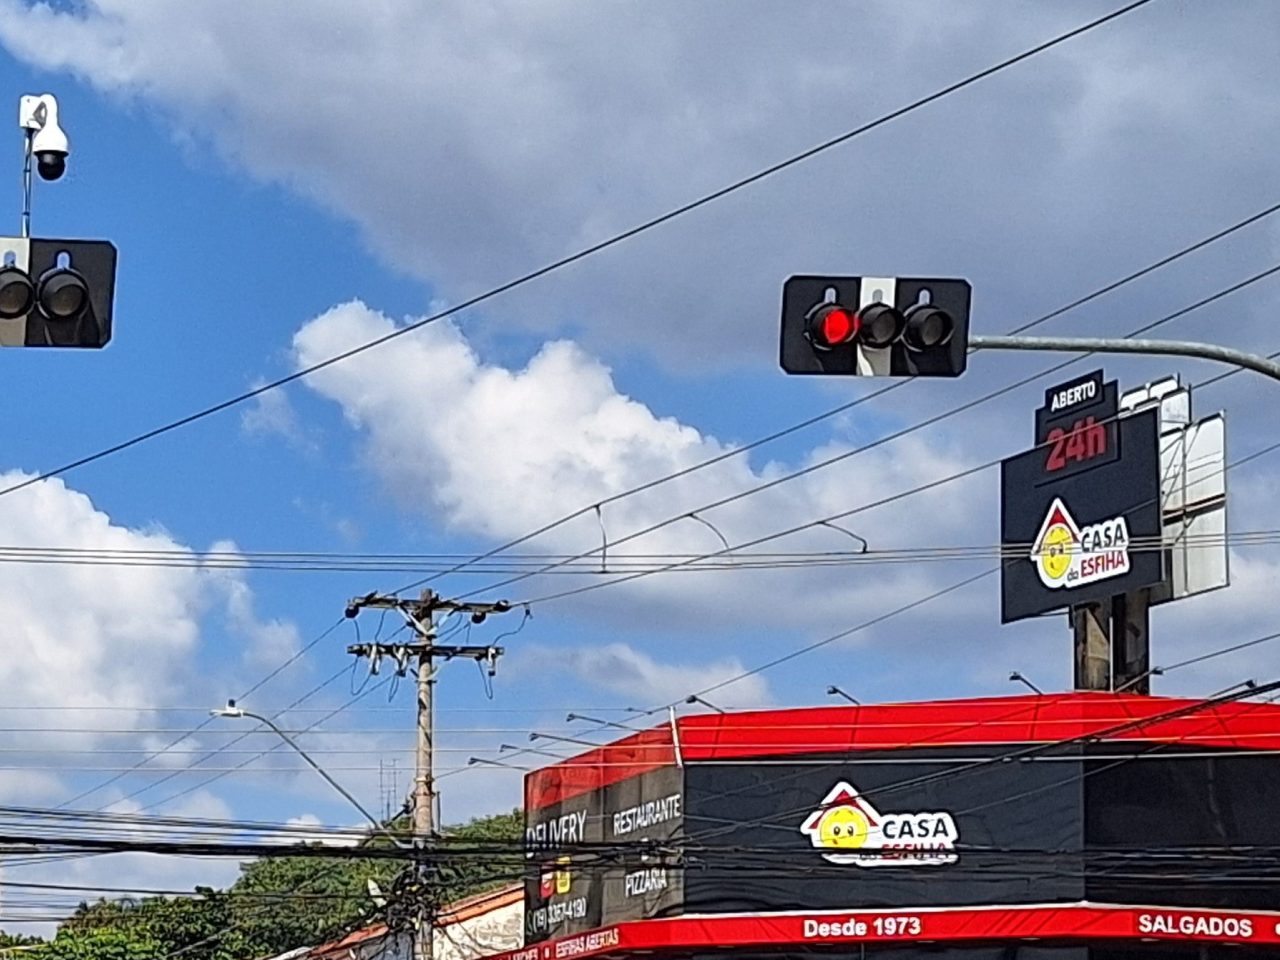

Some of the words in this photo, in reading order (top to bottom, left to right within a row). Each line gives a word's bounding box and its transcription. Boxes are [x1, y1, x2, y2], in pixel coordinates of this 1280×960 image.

[1051, 380, 1096, 412] ABERTO
[1046, 416, 1106, 471] 24h
[1081, 523, 1126, 553] CASA
[1080, 551, 1126, 578] ESFIHA
[613, 793, 681, 836] RESTAURANTE
[882, 818, 949, 839] CASA
[625, 867, 668, 898] PIZZARIA
[803, 918, 867, 937] Desde
[873, 916, 921, 936] 1973
[1139, 914, 1253, 937] SALGADOS
